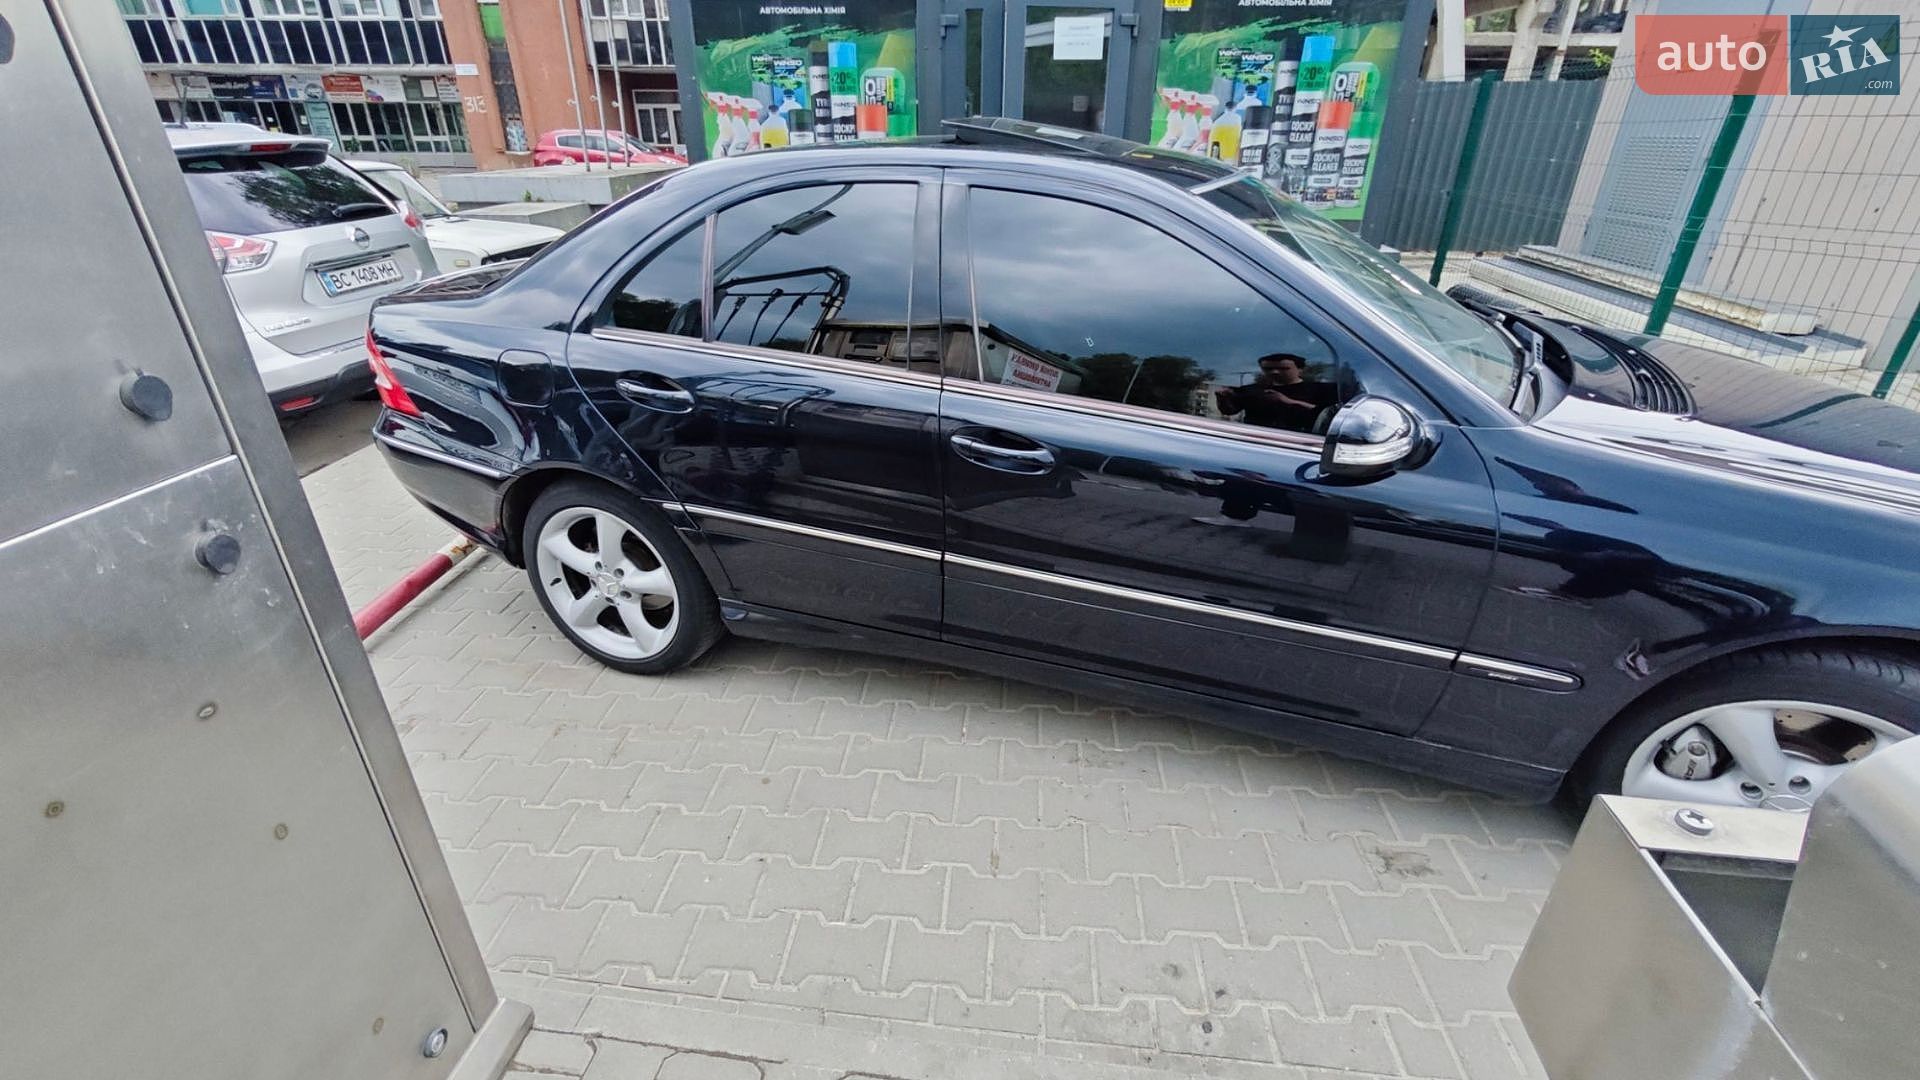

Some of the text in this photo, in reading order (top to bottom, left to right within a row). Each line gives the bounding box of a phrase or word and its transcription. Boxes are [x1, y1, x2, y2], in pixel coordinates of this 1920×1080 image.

[760, 7, 846, 15] АВТОМОБІЛЬНА ХІМІЯ
[331, 272, 351, 288] BC
[351, 266, 378, 284] 1408
